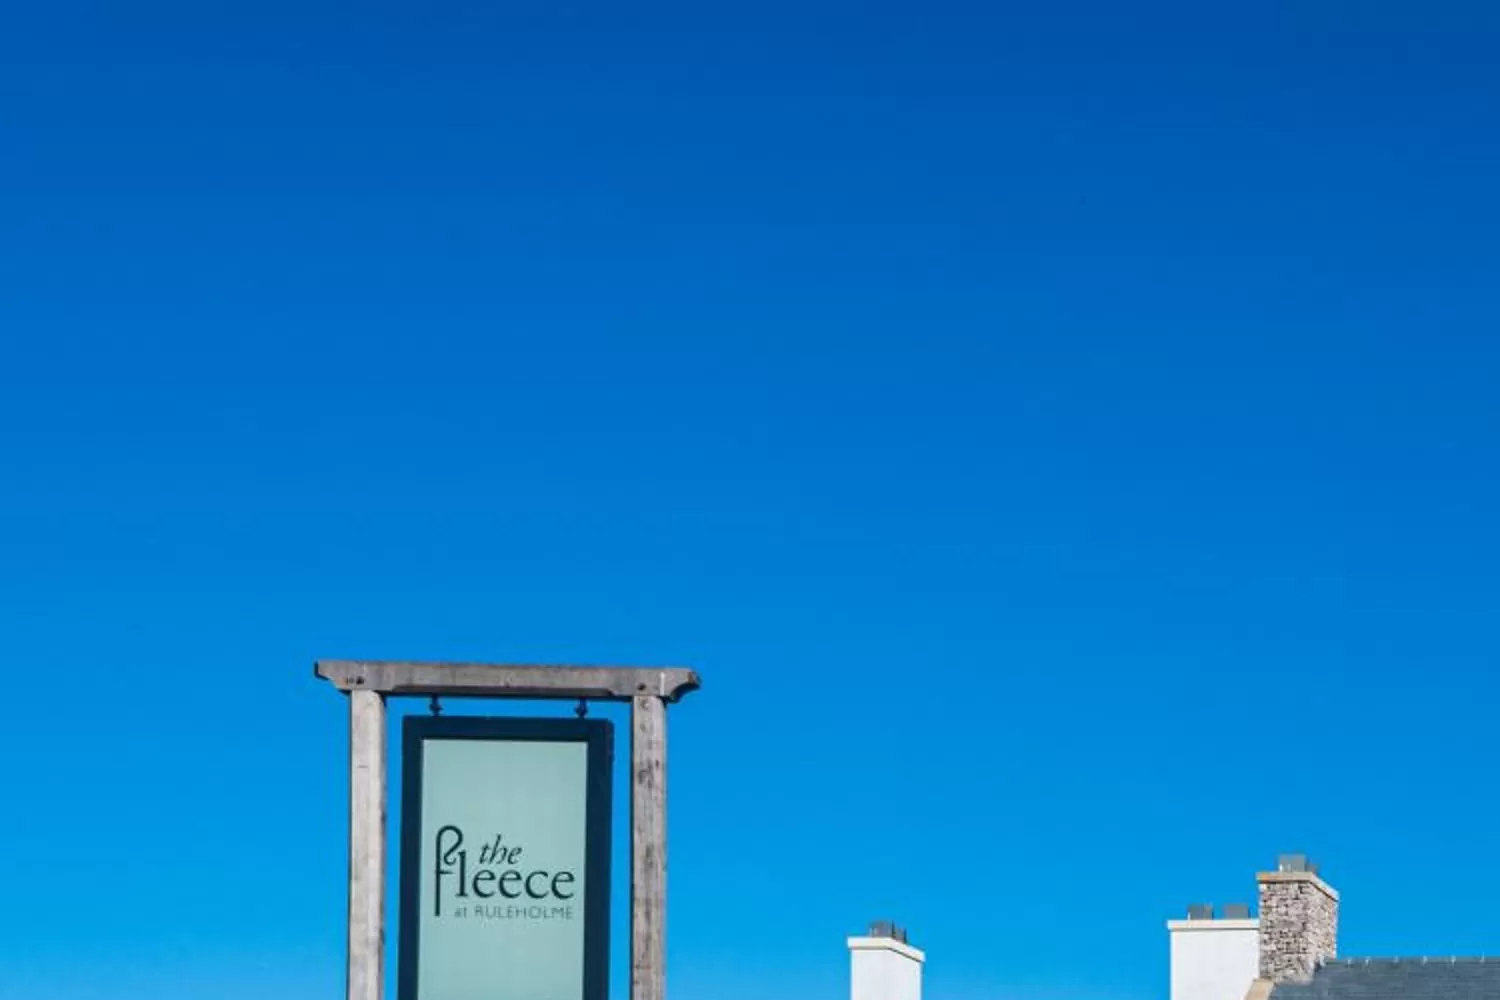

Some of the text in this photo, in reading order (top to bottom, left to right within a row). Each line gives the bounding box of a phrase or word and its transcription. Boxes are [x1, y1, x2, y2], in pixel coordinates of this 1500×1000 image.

[479, 834, 522, 865] the
[454, 905, 574, 919] at RULEHOLME
